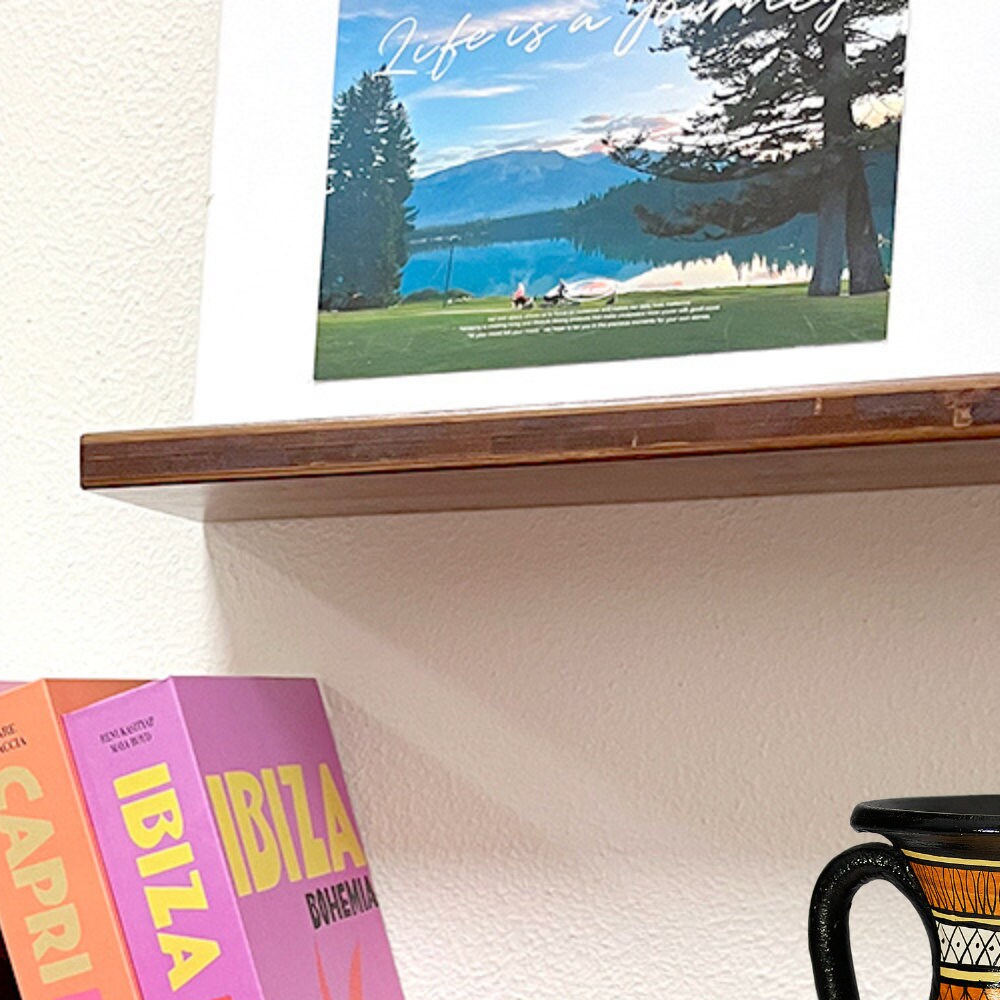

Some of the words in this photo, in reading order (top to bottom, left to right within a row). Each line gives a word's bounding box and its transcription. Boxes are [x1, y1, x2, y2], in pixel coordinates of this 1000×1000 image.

[372, 12, 496, 82] Life
[506, 19, 558, 53] is
[568, 12, 613, 33] a
[113, 762, 221, 992] IBIZA
[205, 763, 366, 897] IBIZA
[305, 876, 379, 930] BOHEMIA
